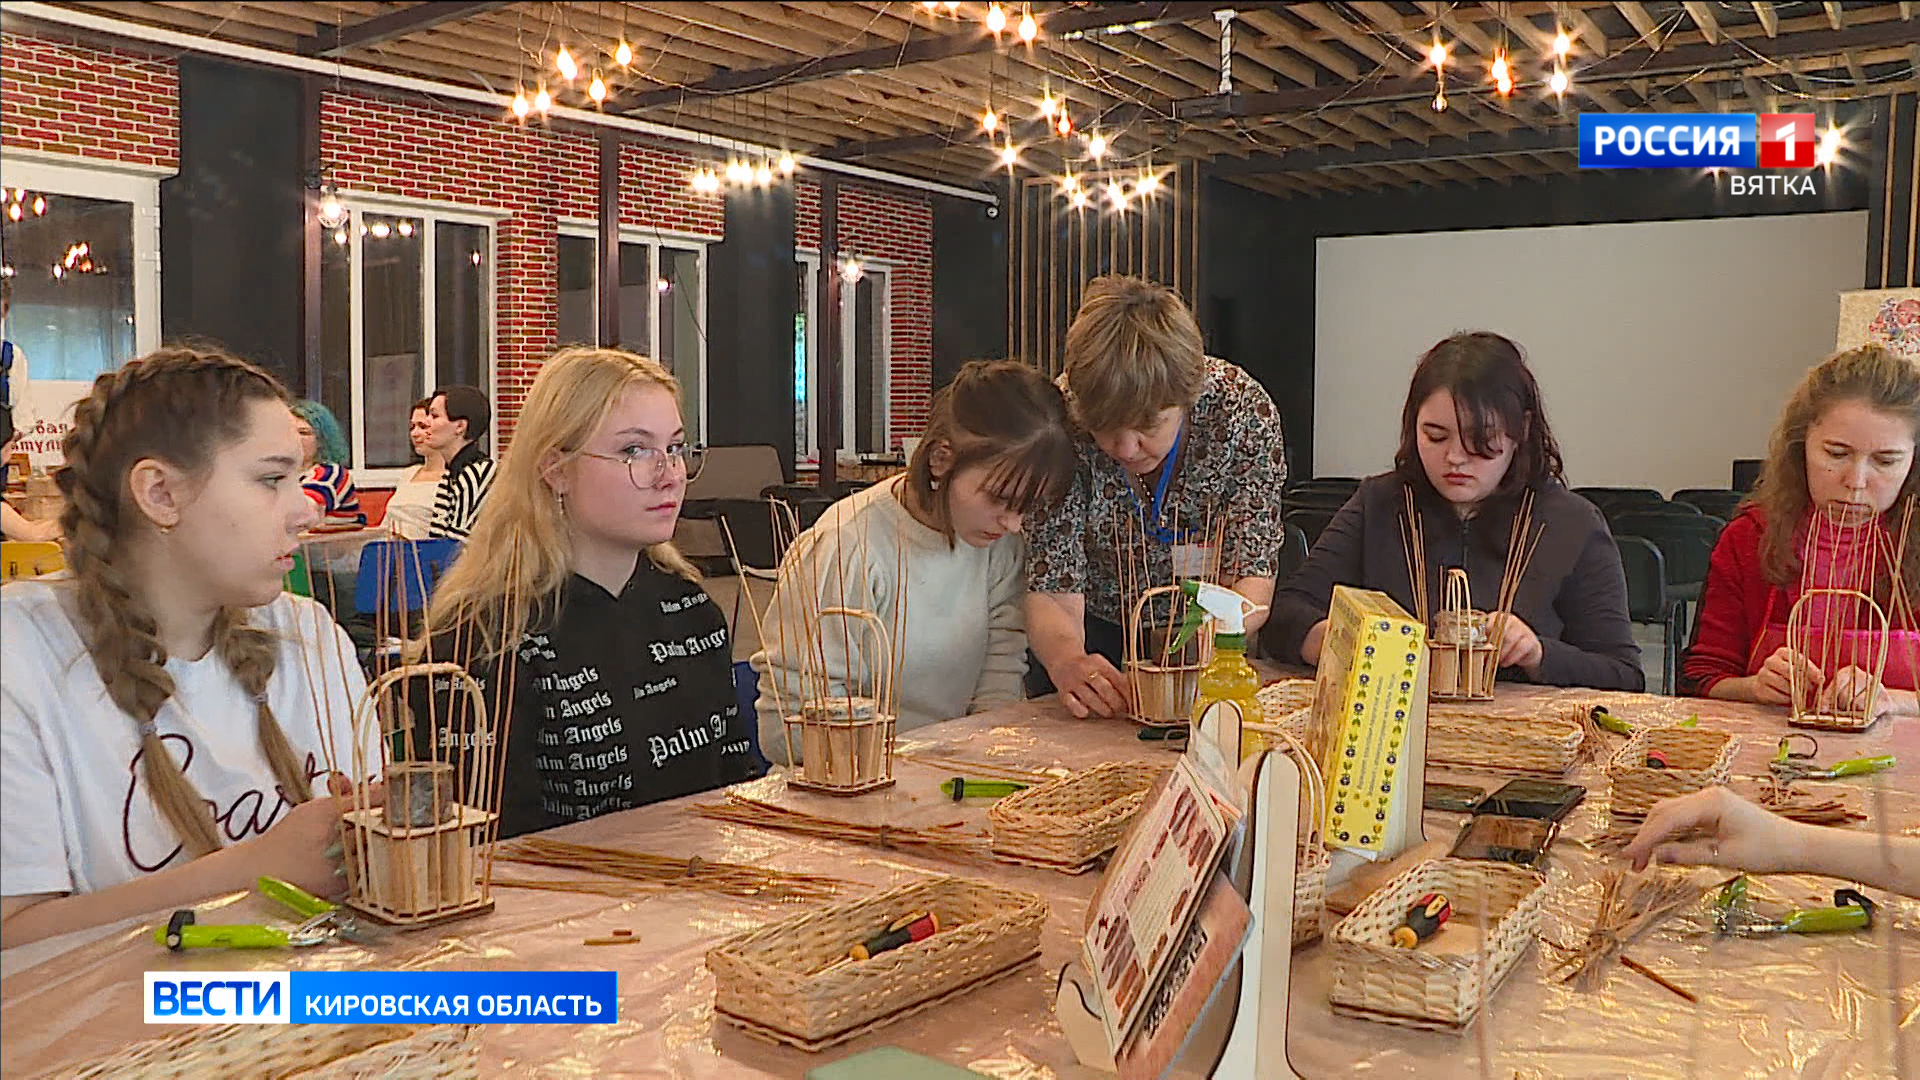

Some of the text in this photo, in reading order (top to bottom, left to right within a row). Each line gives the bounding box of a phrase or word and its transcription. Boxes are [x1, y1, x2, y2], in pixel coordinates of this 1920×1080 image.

[647, 628, 727, 664] Palm Ange
[560, 692, 612, 718] Angels
[438, 727, 497, 751] Anges
[563, 717, 622, 745] Angels
[568, 745, 628, 771] Angels
[647, 727, 710, 769] Palm
[573, 773, 633, 797] Angels
